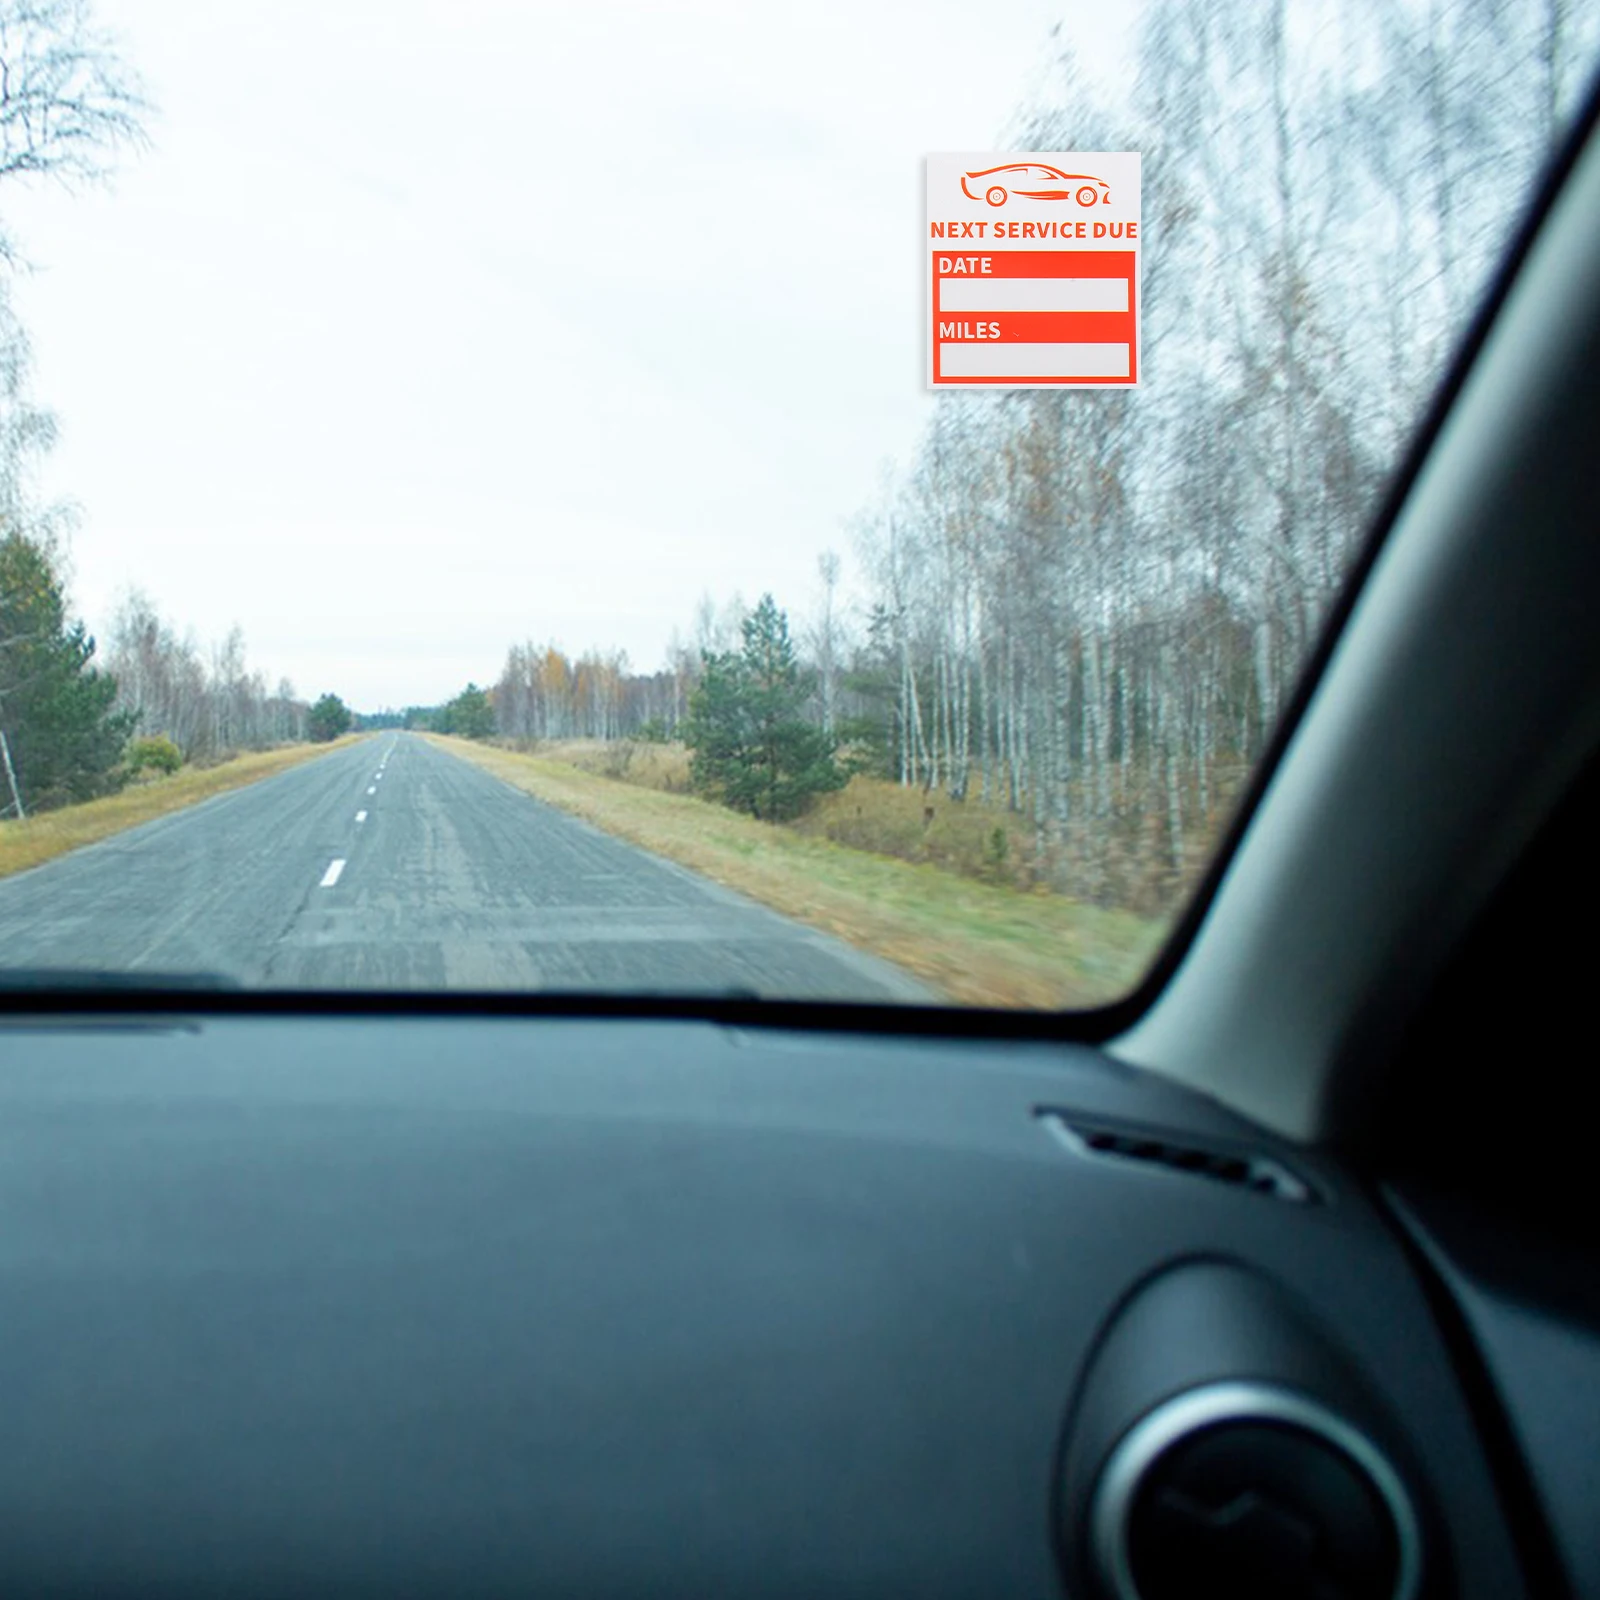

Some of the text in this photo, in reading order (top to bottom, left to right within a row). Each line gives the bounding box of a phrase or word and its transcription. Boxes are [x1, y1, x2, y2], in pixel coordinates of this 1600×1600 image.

[931, 222, 1138, 239] NEXT SERVICE DUE
[939, 257, 992, 274] DATE
[939, 321, 1001, 339] MILES
